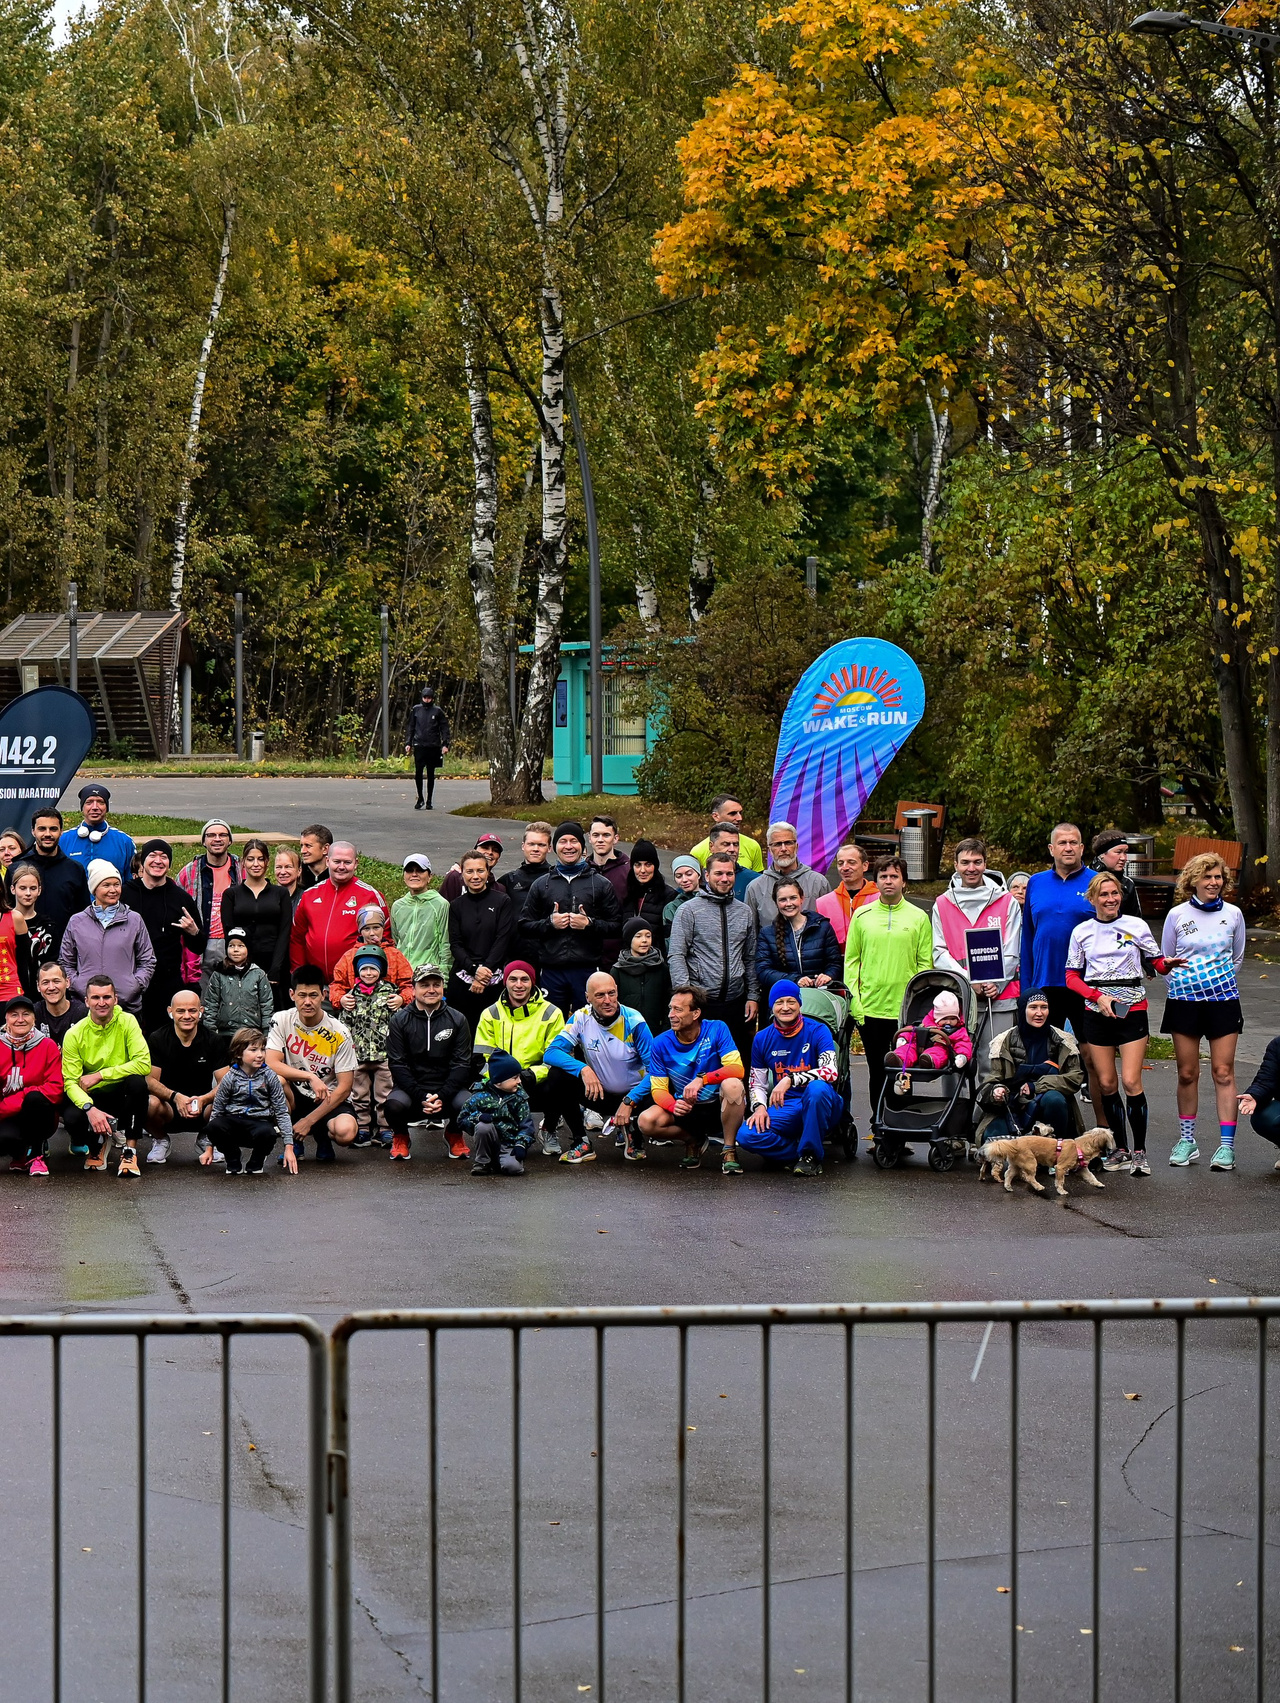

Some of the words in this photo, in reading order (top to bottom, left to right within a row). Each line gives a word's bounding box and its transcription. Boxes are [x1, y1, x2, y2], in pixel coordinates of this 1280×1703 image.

[840, 705, 872, 713] MOSCOW
[802, 714, 858, 733] WAKE
[866, 711, 908, 725] RUN
[18, 788, 61, 799] MARATHON
[987, 915, 1001, 927] Sat
